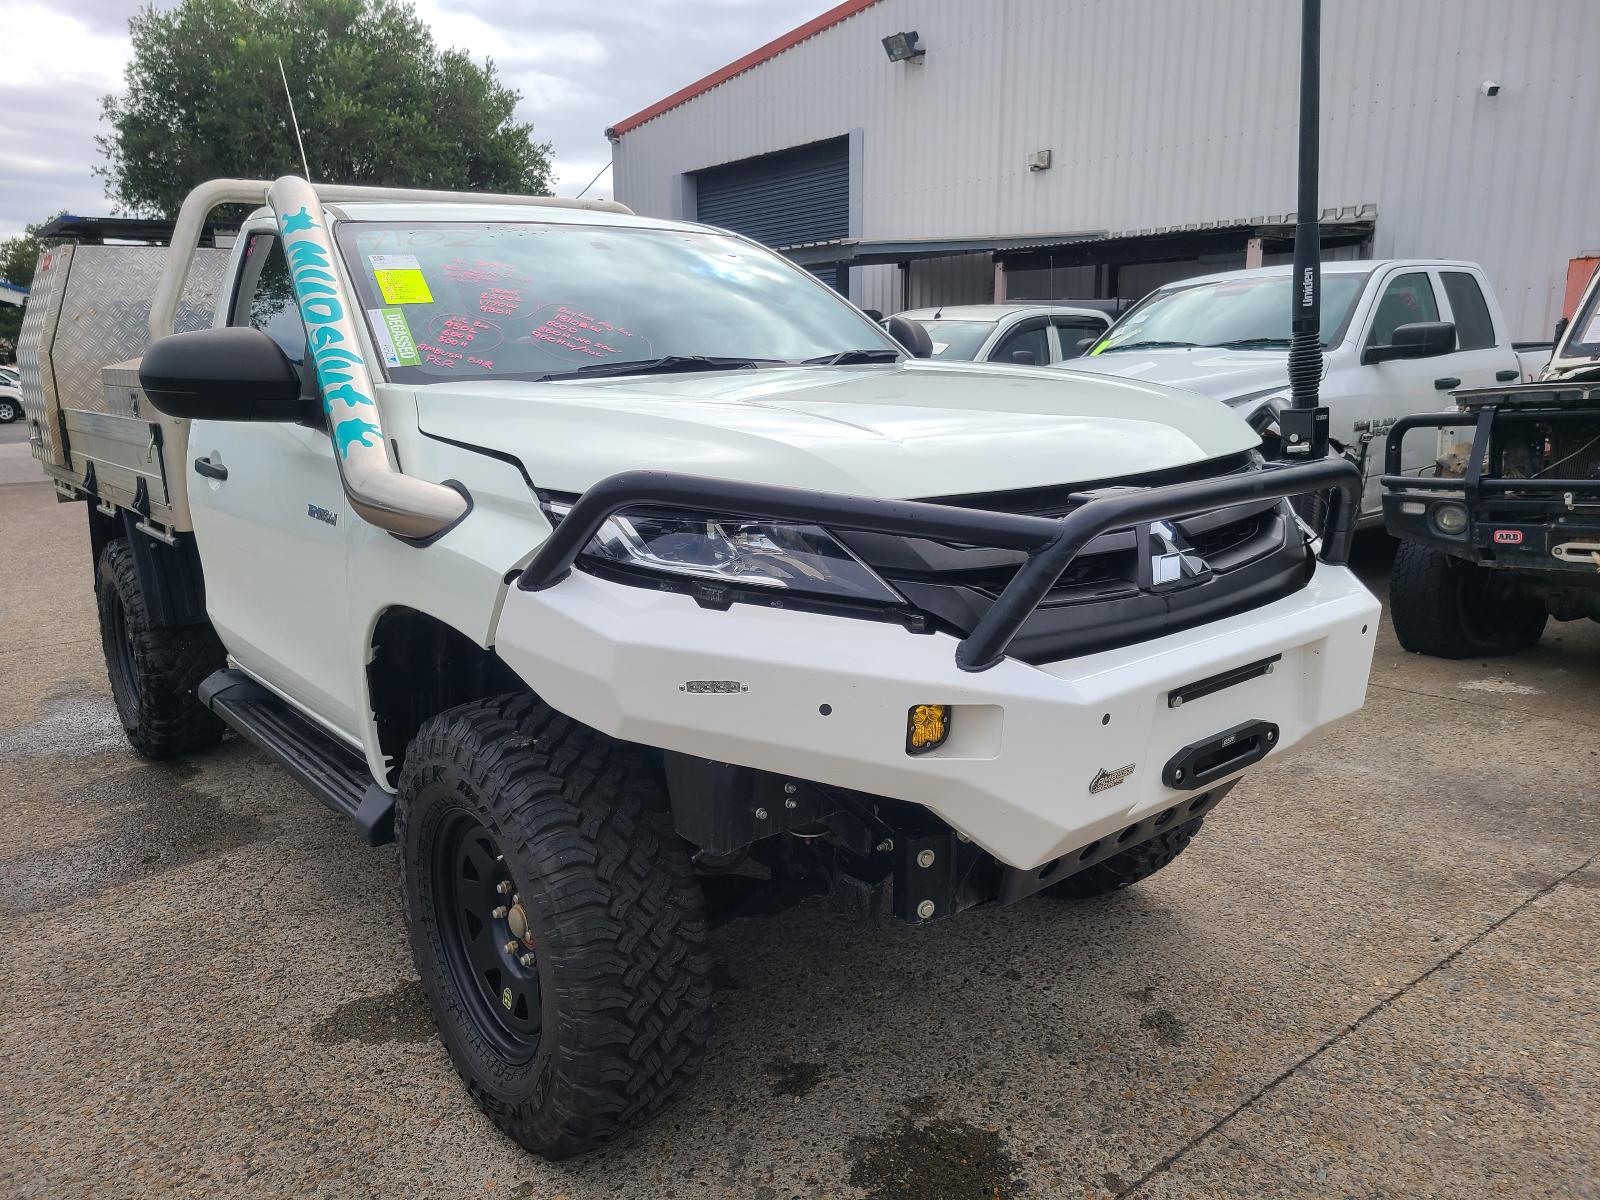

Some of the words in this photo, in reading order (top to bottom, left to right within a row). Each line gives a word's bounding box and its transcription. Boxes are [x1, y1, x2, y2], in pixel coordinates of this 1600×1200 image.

[1303, 267, 1313, 307] Uniden
[386, 314, 416, 359] DEGASSED
[1498, 533, 1519, 541] ARB
